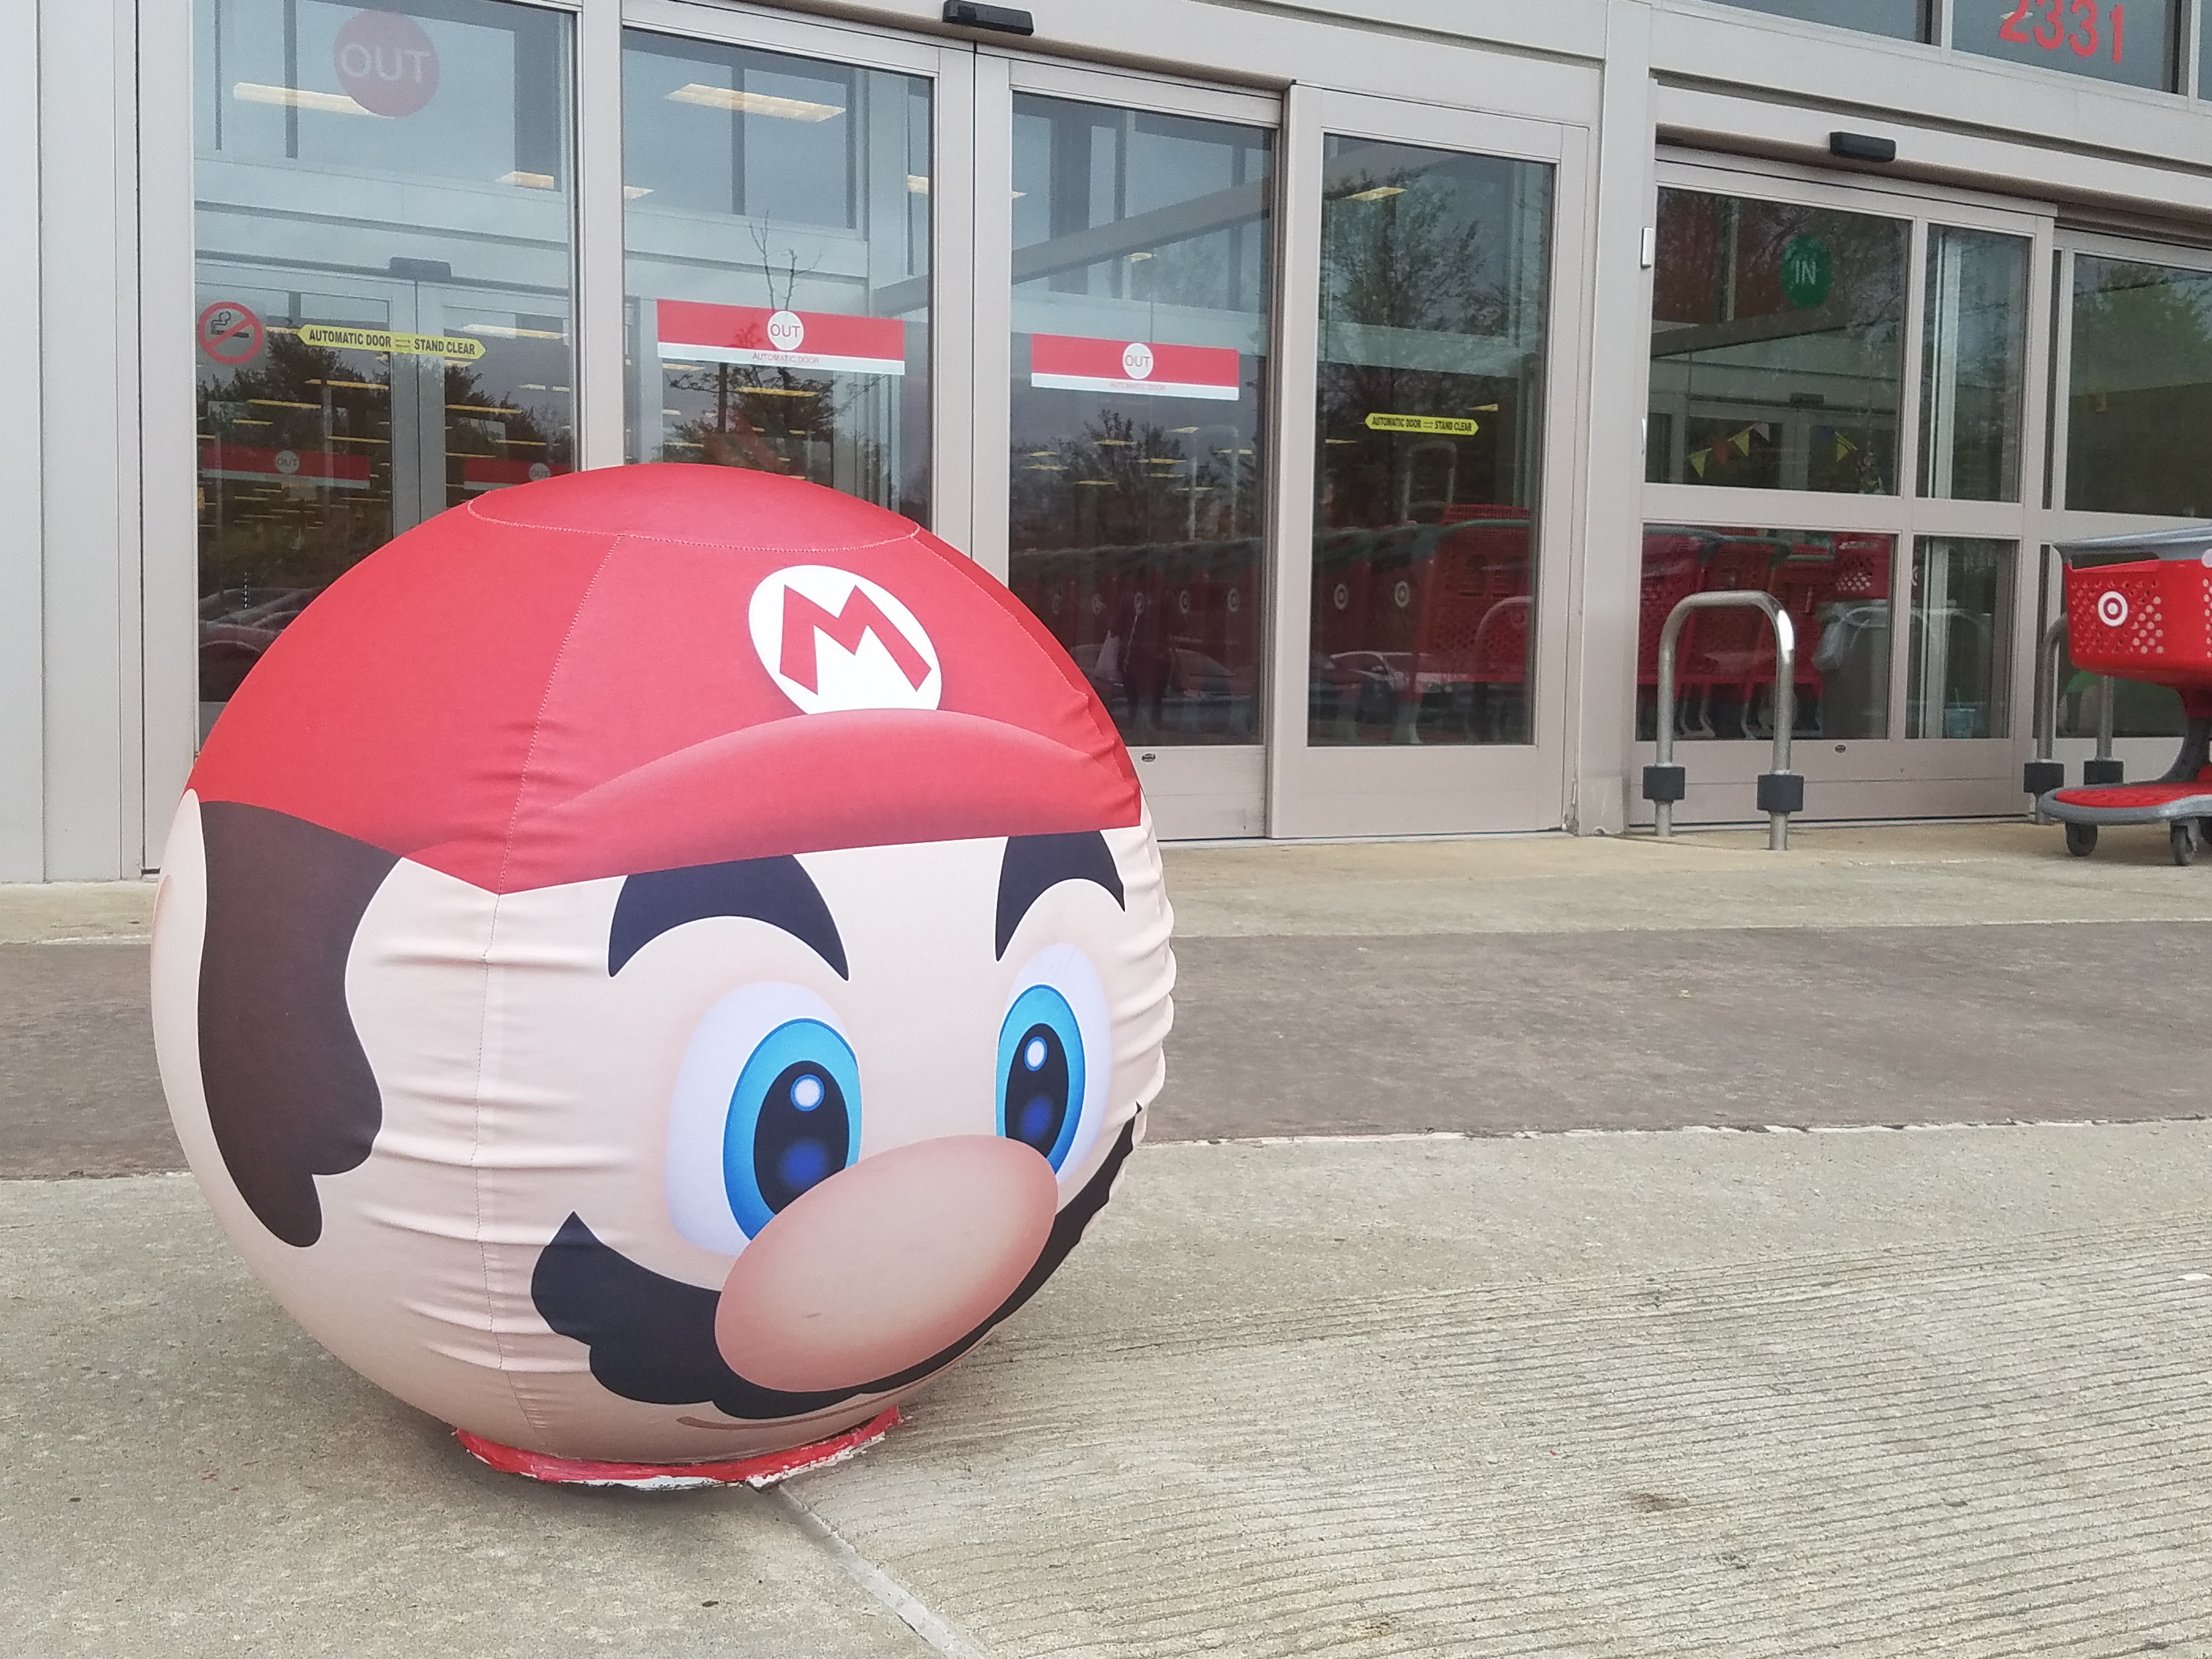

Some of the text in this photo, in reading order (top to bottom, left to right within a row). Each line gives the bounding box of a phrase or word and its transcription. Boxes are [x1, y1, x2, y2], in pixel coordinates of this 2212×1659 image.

[1999, 0, 2124, 64] 2331
[340, 43, 432, 83] OUT
[1795, 260, 1816, 285] IN
[770, 323, 801, 338] OUT
[309, 329, 476, 355] AUTOMATIC DOOR STAND CLEAR
[752, 352, 820, 364] AUTOMATIC DOOR
[1125, 354, 1152, 368] OUT
[1372, 416, 1472, 432] AUTOMATIC DOOR STAND CLEAR
[277, 457, 298, 466] OUT
[779, 584, 932, 696] M
